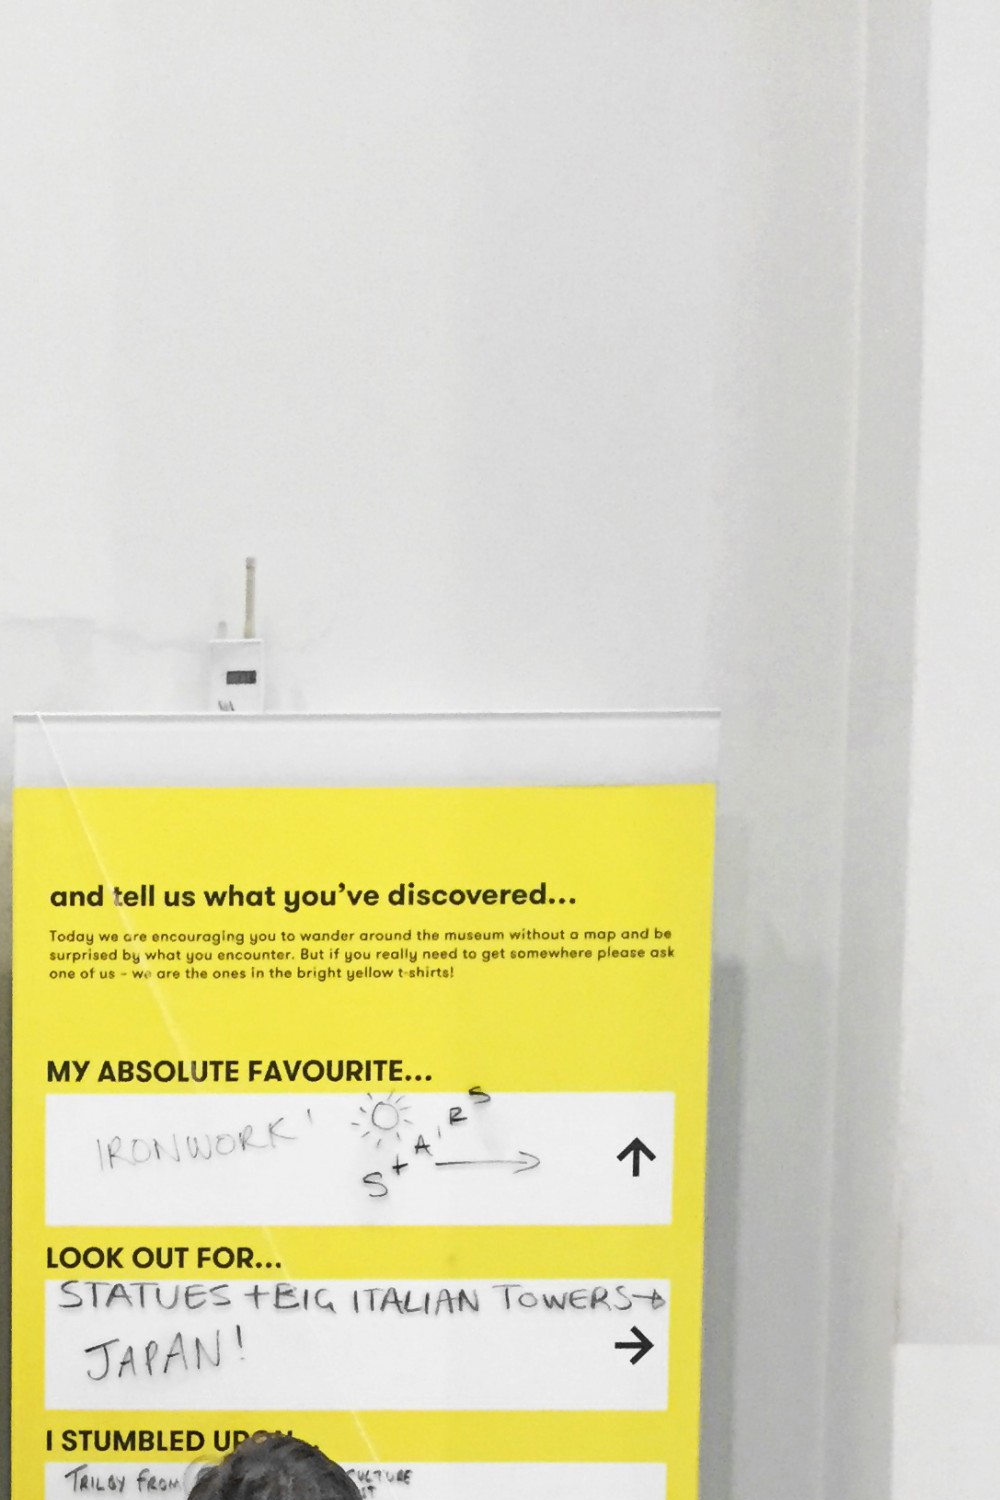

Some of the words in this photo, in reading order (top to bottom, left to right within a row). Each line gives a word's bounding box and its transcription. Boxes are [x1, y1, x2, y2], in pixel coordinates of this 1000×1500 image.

[50, 884, 103, 907] and
[113, 884, 155, 907] tell
[164, 891, 195, 907] us
[203, 884, 275, 906] what
[284, 882, 379, 912] you’ve
[388, 882, 576, 906] discovered...
[49, 930, 94, 945] Today
[99, 934, 118, 942] we
[123, 933, 147, 942] are
[152, 930, 244, 946] encouraging
[250, 933, 275, 945] you
[281, 932, 295, 941] to
[300, 930, 354, 941] wander
[360, 930, 411, 941] around
[417, 929, 439, 941] the
[445, 932, 504, 941] museum
[510, 928, 564, 940] without
[584, 931, 616, 942] map
[621, 928, 649, 939] and
[654, 928, 671, 939] be
[50, 948, 117, 963] surprised
[123, 949, 140, 963] by
[145, 949, 181, 961] what
[186, 952, 212, 962] you
[218, 950, 294, 960] encounter.
[301, 948, 324, 960] But
[330, 948, 339, 959] if
[345, 951, 370, 961] you
[376, 948, 417, 961] really
[423, 948, 457, 959] need
[463, 949, 476, 959] to
[482, 948, 505, 961] get
[510, 947, 592, 959] somewhere
[598, 946, 645, 960] please
[650, 946, 674, 958] ask
[49, 970, 75, 979] one
[80, 968, 95, 979] of
[100, 971, 115, 979] us
[157, 970, 180, 979] are
[185, 967, 207, 979] the
[213, 970, 246, 979] ones
[252, 967, 264, 978] in
[269, 967, 292, 978] the
[297, 967, 341, 982] bright
[347, 966, 393, 982] yellow
[47, 1060, 90, 1082] MY
[97, 1060, 239, 1083] ABSOLUTE
[249, 1059, 432, 1082] FAVOURITE...
[47, 1246, 124, 1269] LOOK
[132, 1247, 189, 1269] OUT
[197, 1246, 281, 1269] FOR...
[59, 1282, 231, 1309] STATUES
[353, 1287, 479, 1315] ITALIAN
[492, 1284, 636, 1311] TOWERS
[84, 1325, 244, 1381] JAPAN!
[47, 1430, 52, 1451] I
[62, 1429, 205, 1451] STUMBLED
